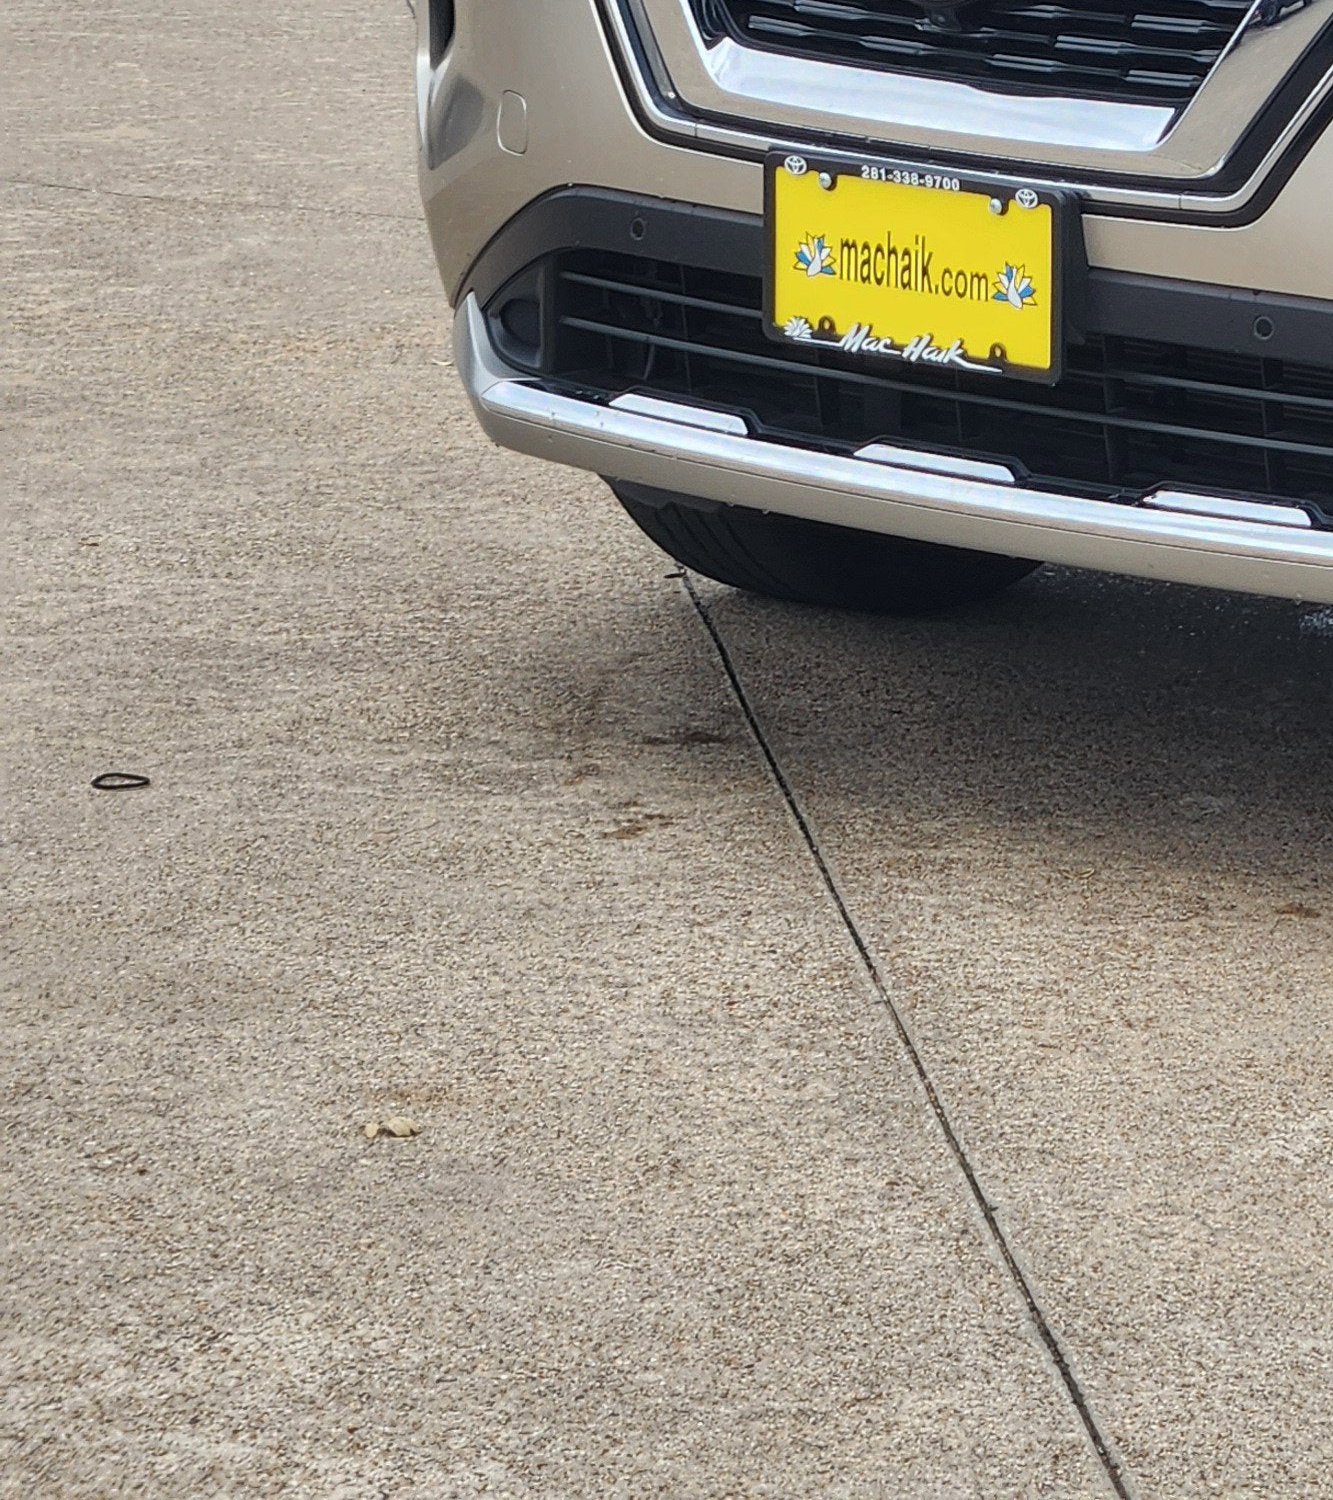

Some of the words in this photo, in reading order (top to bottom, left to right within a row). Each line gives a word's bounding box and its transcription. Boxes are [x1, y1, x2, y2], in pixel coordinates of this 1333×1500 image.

[860, 164, 961, 192] 281-338-9700
[839, 230, 990, 302] machaik.com
[838, 322, 897, 355] Mac
